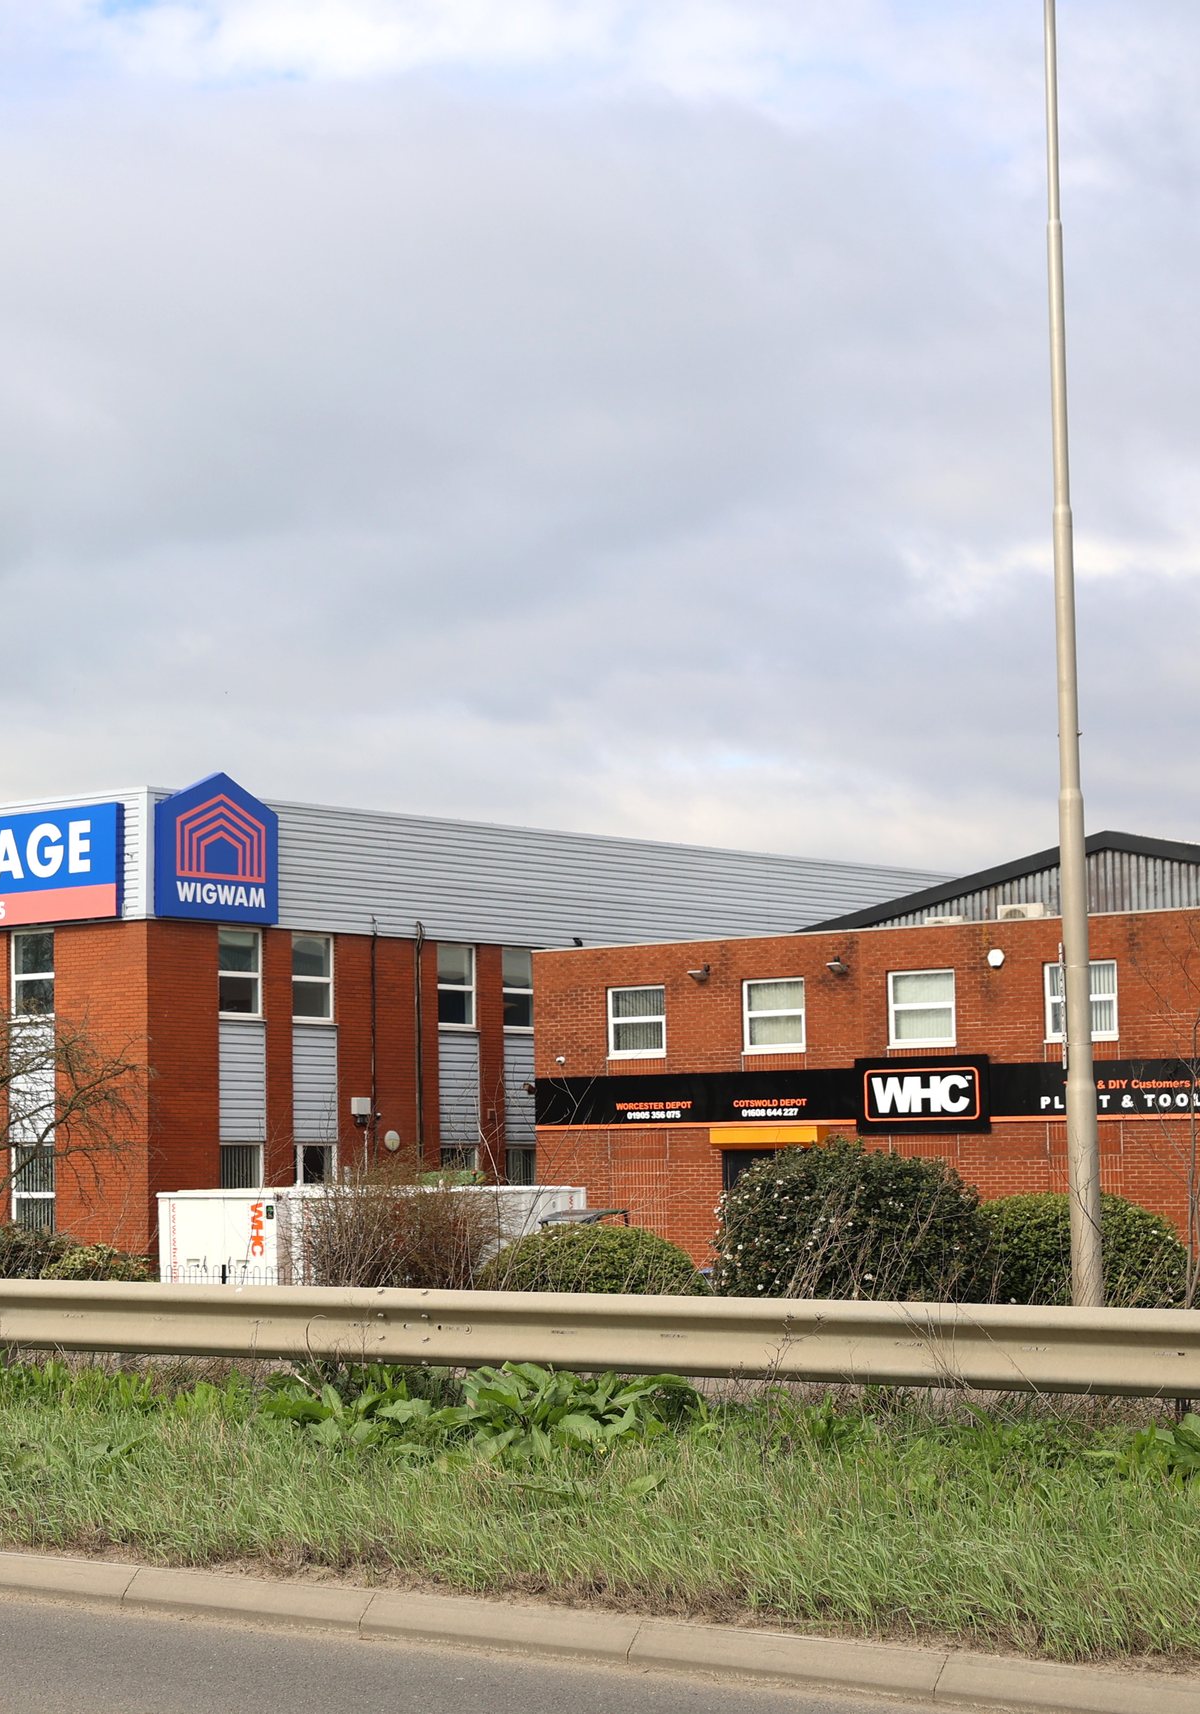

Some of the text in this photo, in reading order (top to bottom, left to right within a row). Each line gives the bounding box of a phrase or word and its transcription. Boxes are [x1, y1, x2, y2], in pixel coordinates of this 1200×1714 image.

[176, 881, 266, 908] WIGWAM
[1097, 1080, 1105, 1089] &
[1108, 1079, 1128, 1090] DIY
[1131, 1079, 1191, 1089] Customers
[871, 1074, 971, 1114] WHC
[616, 1101, 692, 1111] WORCESTER DEPOT
[733, 1098, 807, 1108] COTSWOLD DEPOT
[1040, 1094, 1111, 1109] PLT
[1121, 1094, 1134, 1108] &
[626, 1109, 681, 1120] 01905 356 075
[741, 1107, 799, 1118] 01608 644 227
[250, 1202, 264, 1257] WHC
